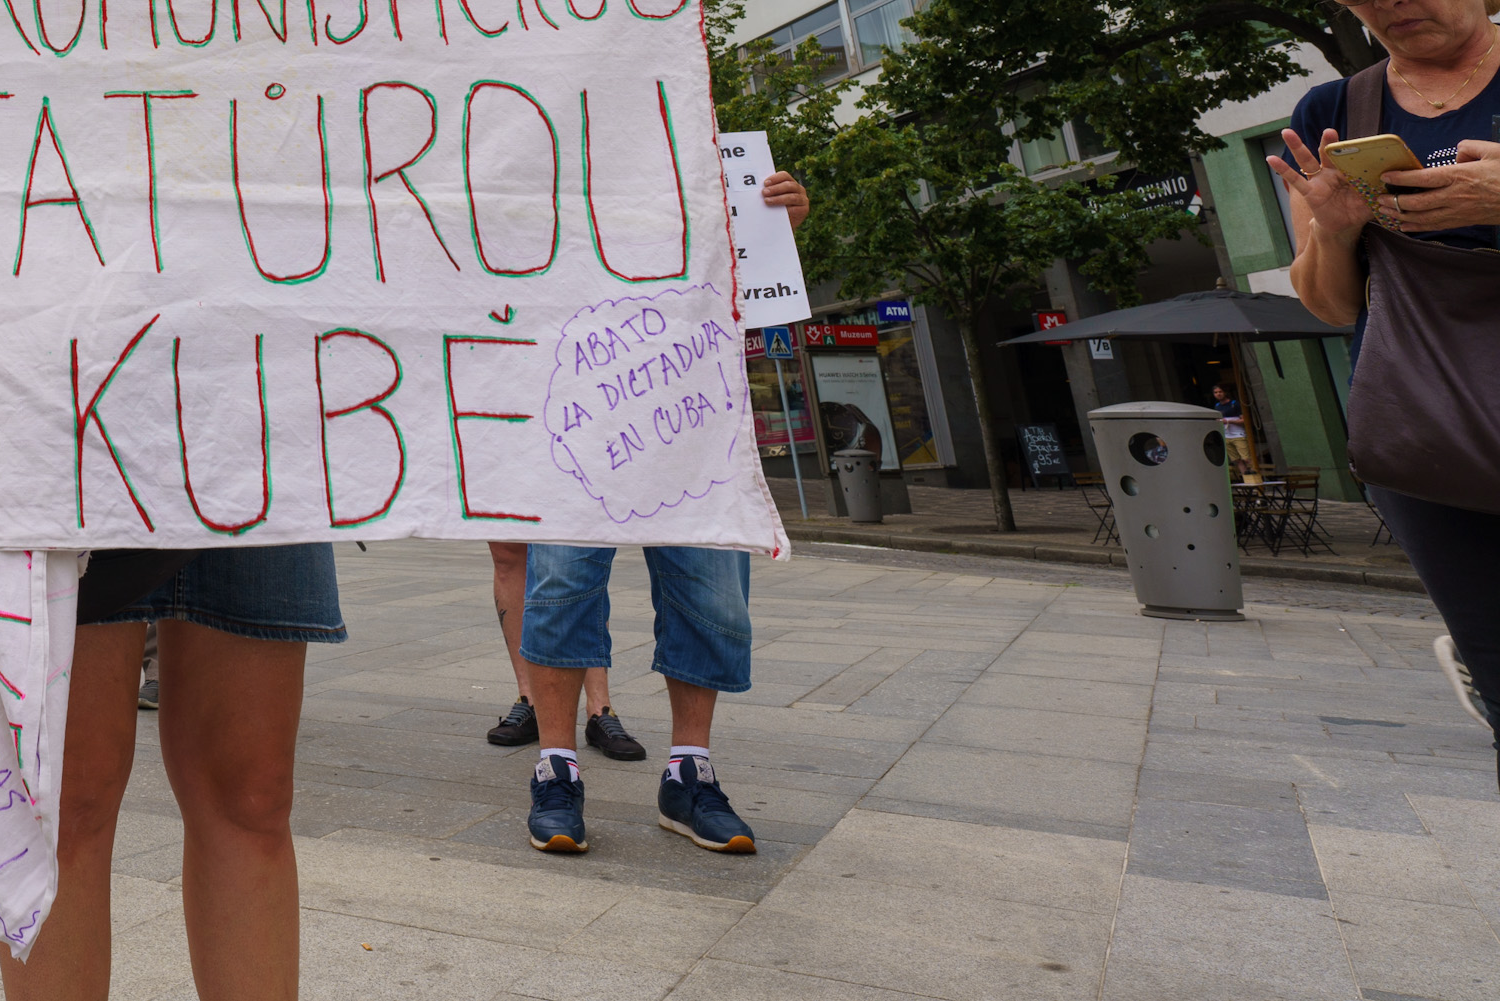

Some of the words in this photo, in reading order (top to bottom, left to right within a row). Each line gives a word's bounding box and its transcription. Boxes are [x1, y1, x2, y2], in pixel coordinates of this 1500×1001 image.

[743, 174, 757, 186] a
[886, 307, 908, 316] ATM
[840, 330, 872, 339] Muzeum
[563, 402, 592, 432] LA
[597, 320, 733, 411] DICTADURA
[70, 304, 542, 535] KUBĚ
[606, 423, 645, 470] EN
